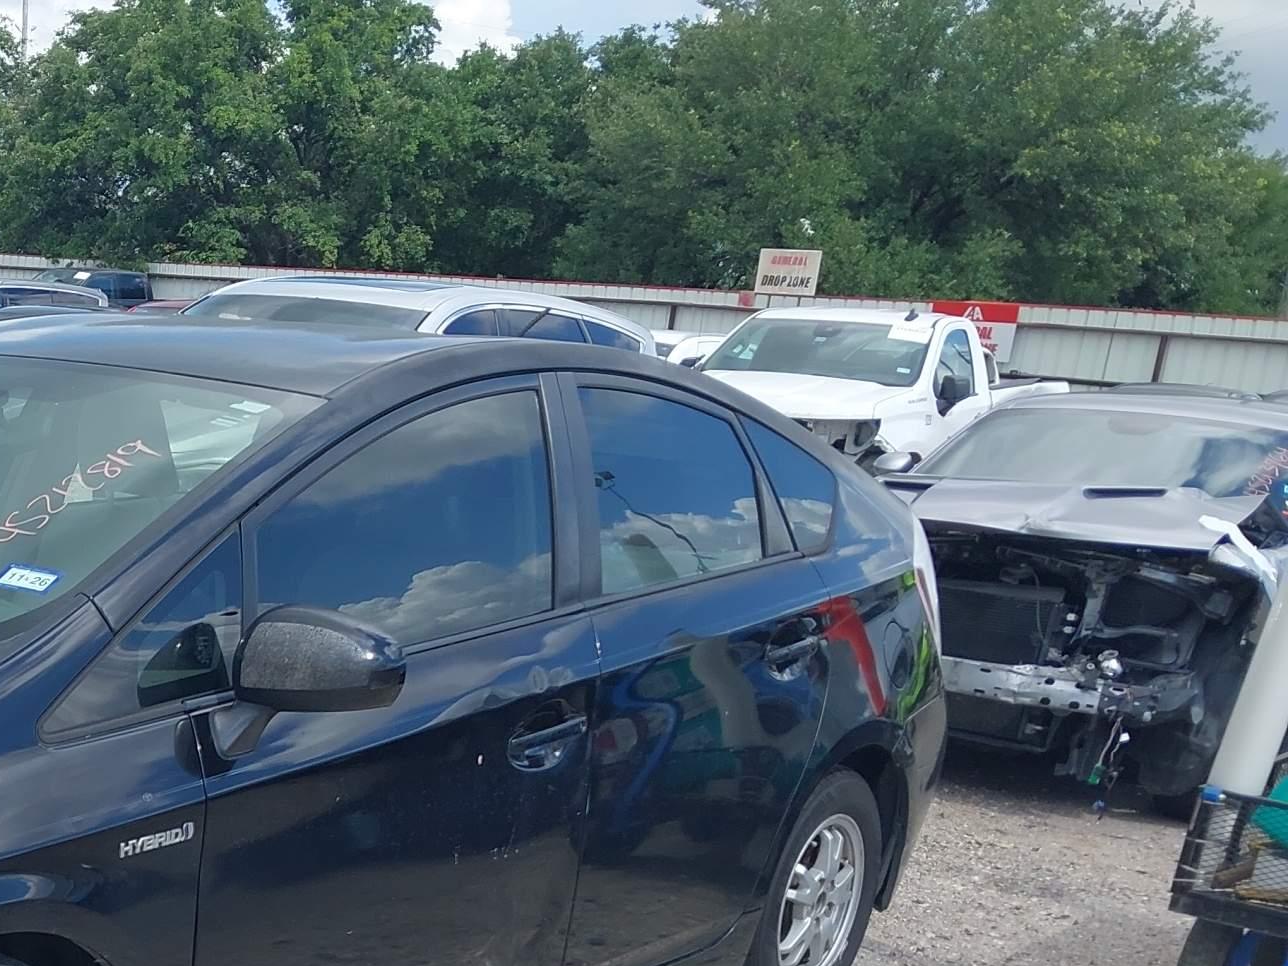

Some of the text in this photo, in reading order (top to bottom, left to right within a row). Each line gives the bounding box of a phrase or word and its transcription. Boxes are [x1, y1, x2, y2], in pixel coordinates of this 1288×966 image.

[760, 274, 812, 288] DROP ZONE
[119, 827, 184, 859] HYBRID
